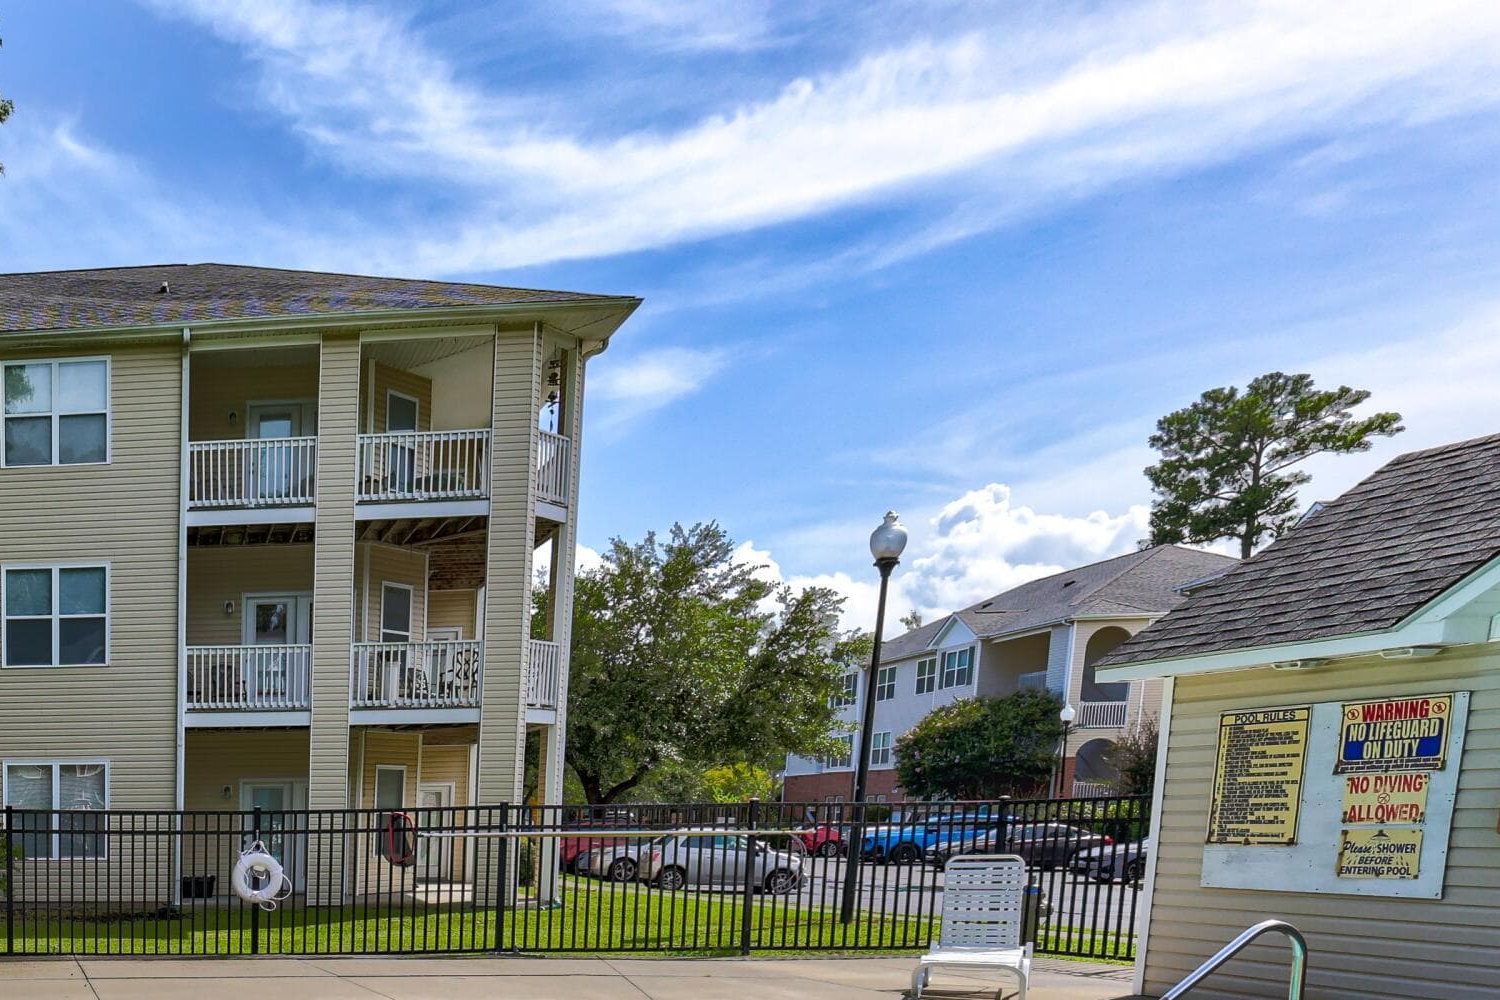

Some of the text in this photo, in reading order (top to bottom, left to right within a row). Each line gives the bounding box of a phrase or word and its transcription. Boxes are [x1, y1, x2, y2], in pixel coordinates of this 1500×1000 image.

[1235, 711, 1296, 724] POOL RULES
[1362, 700, 1430, 722] WARNING
[1349, 718, 1440, 742] NO LIFEGUARD
[1363, 738, 1420, 759] ON DUTY
[1349, 774, 1423, 794] NO DIVING
[1347, 803, 1420, 822] ALLOWED
[1376, 843, 1417, 854] SHOWER
[1358, 856, 1395, 865] BEFORE
[1340, 866, 1411, 876] ENTERING POOL
